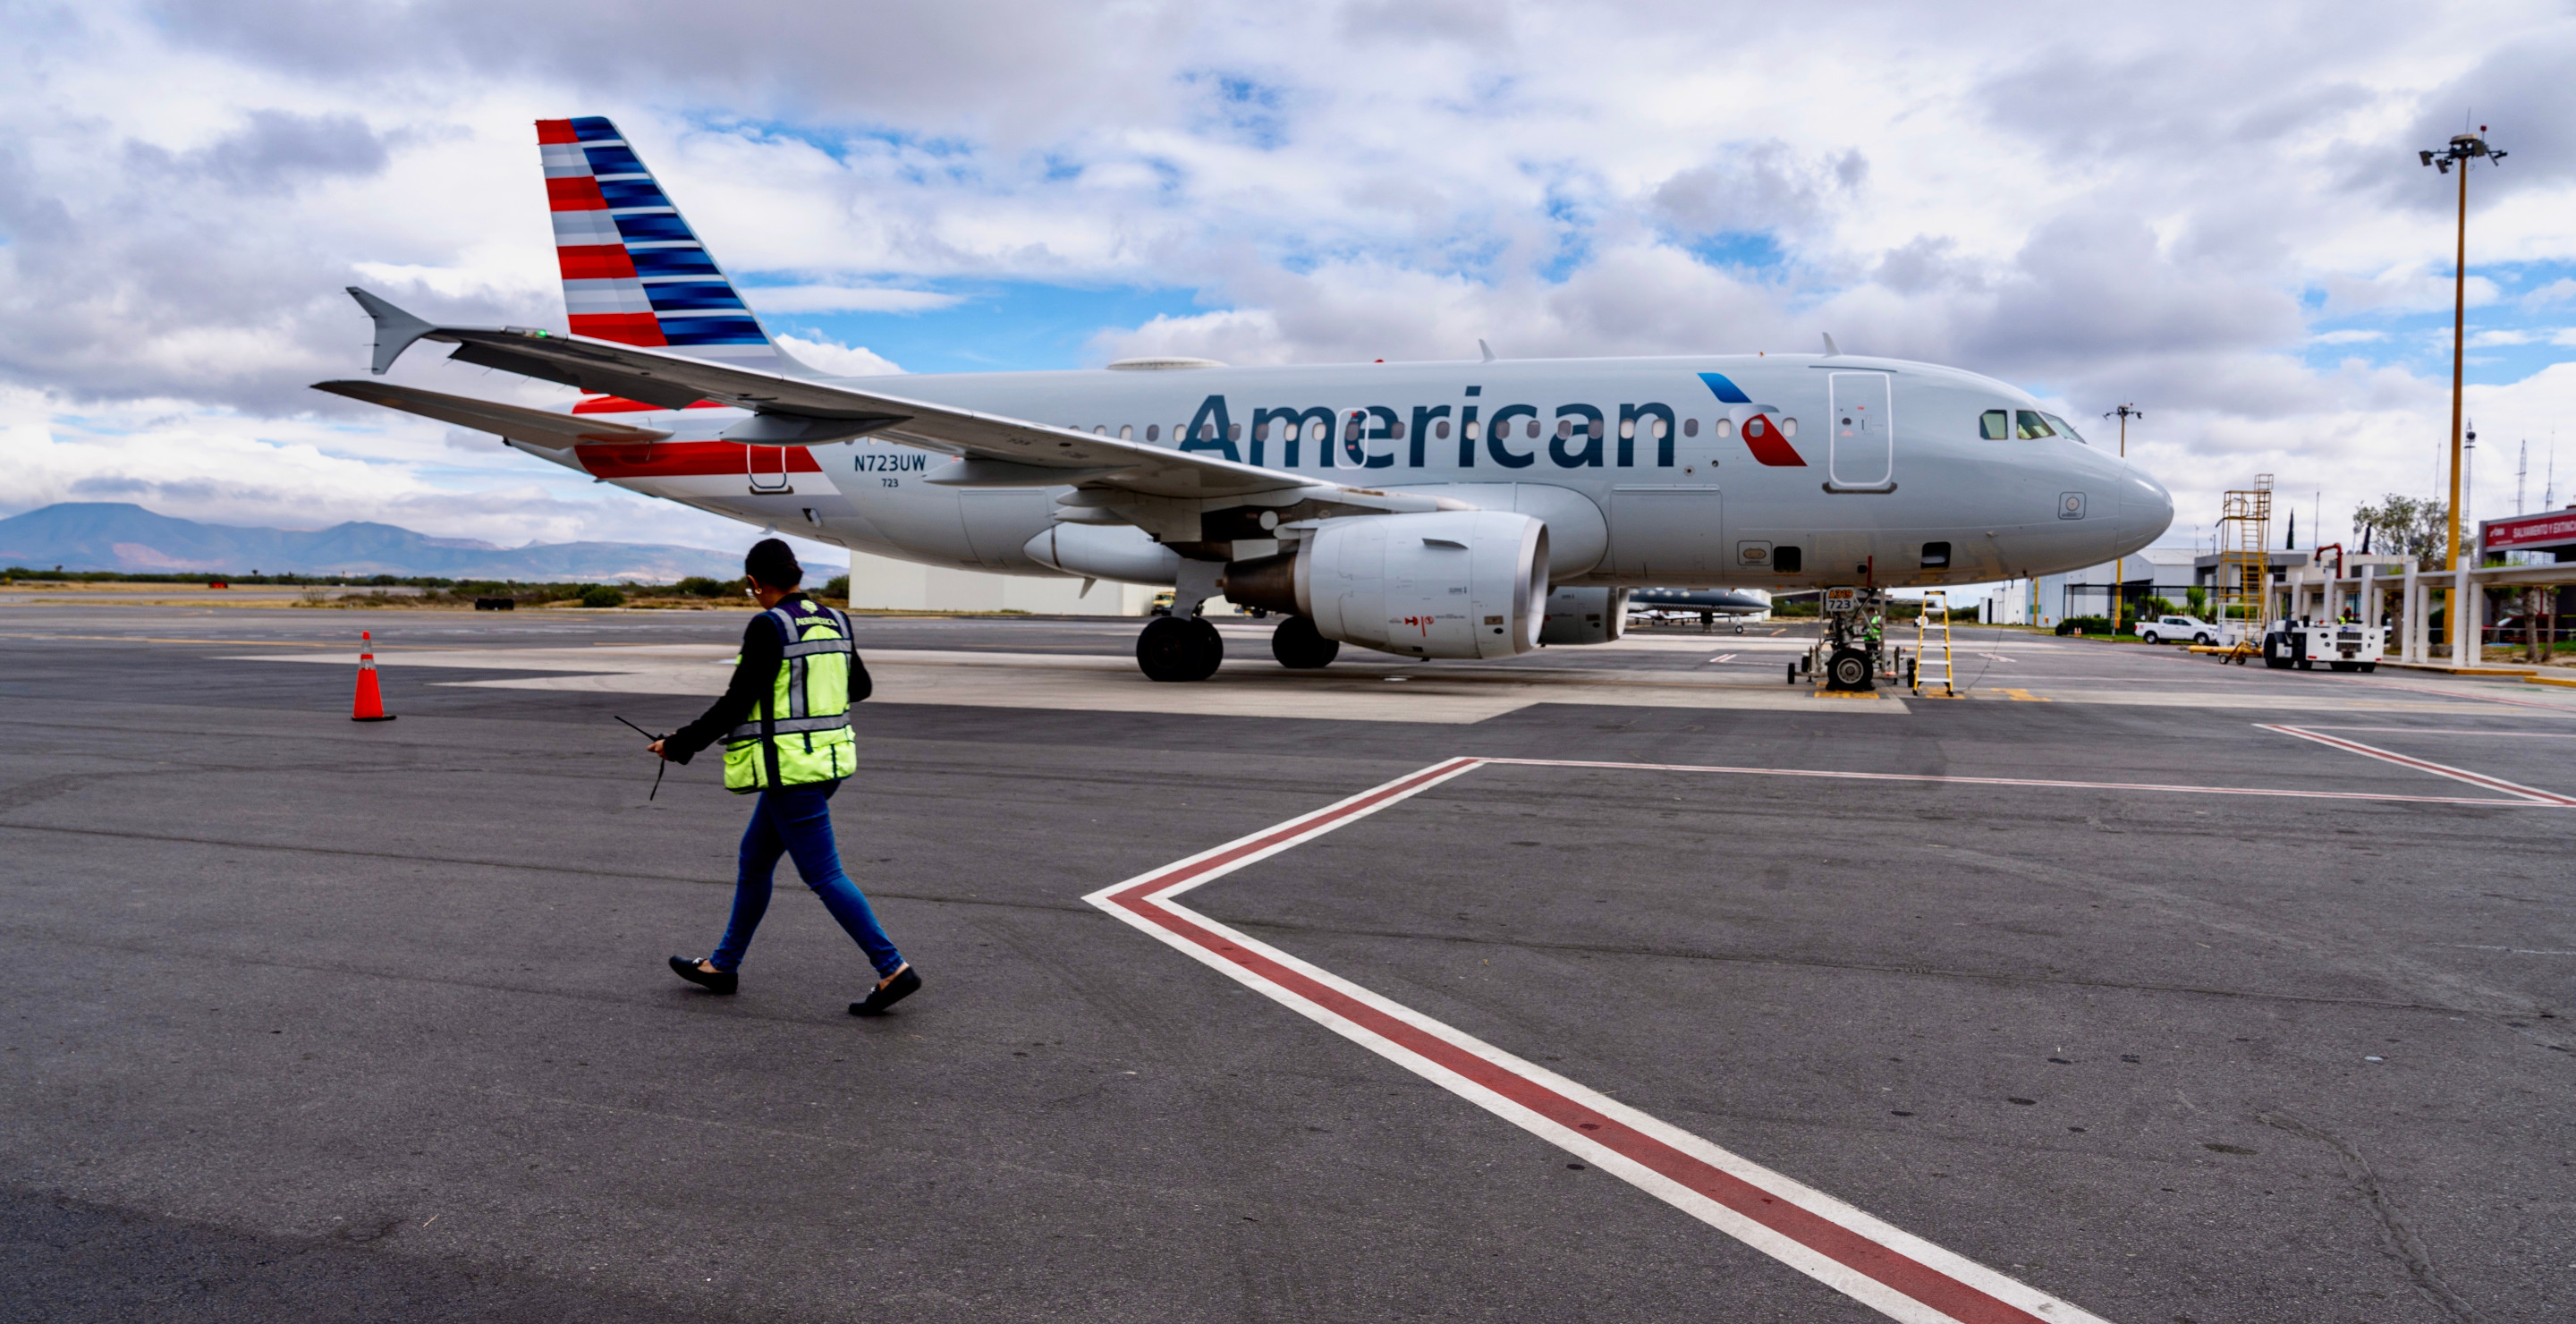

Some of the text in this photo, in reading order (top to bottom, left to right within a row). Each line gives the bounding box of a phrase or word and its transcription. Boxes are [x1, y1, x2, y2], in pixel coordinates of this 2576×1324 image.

[1179, 386, 1676, 468] American
[855, 454, 926, 471] N723UW
[881, 479, 899, 488] 723
[1828, 589, 1853, 598] A319
[1828, 600, 1851, 608] 723
